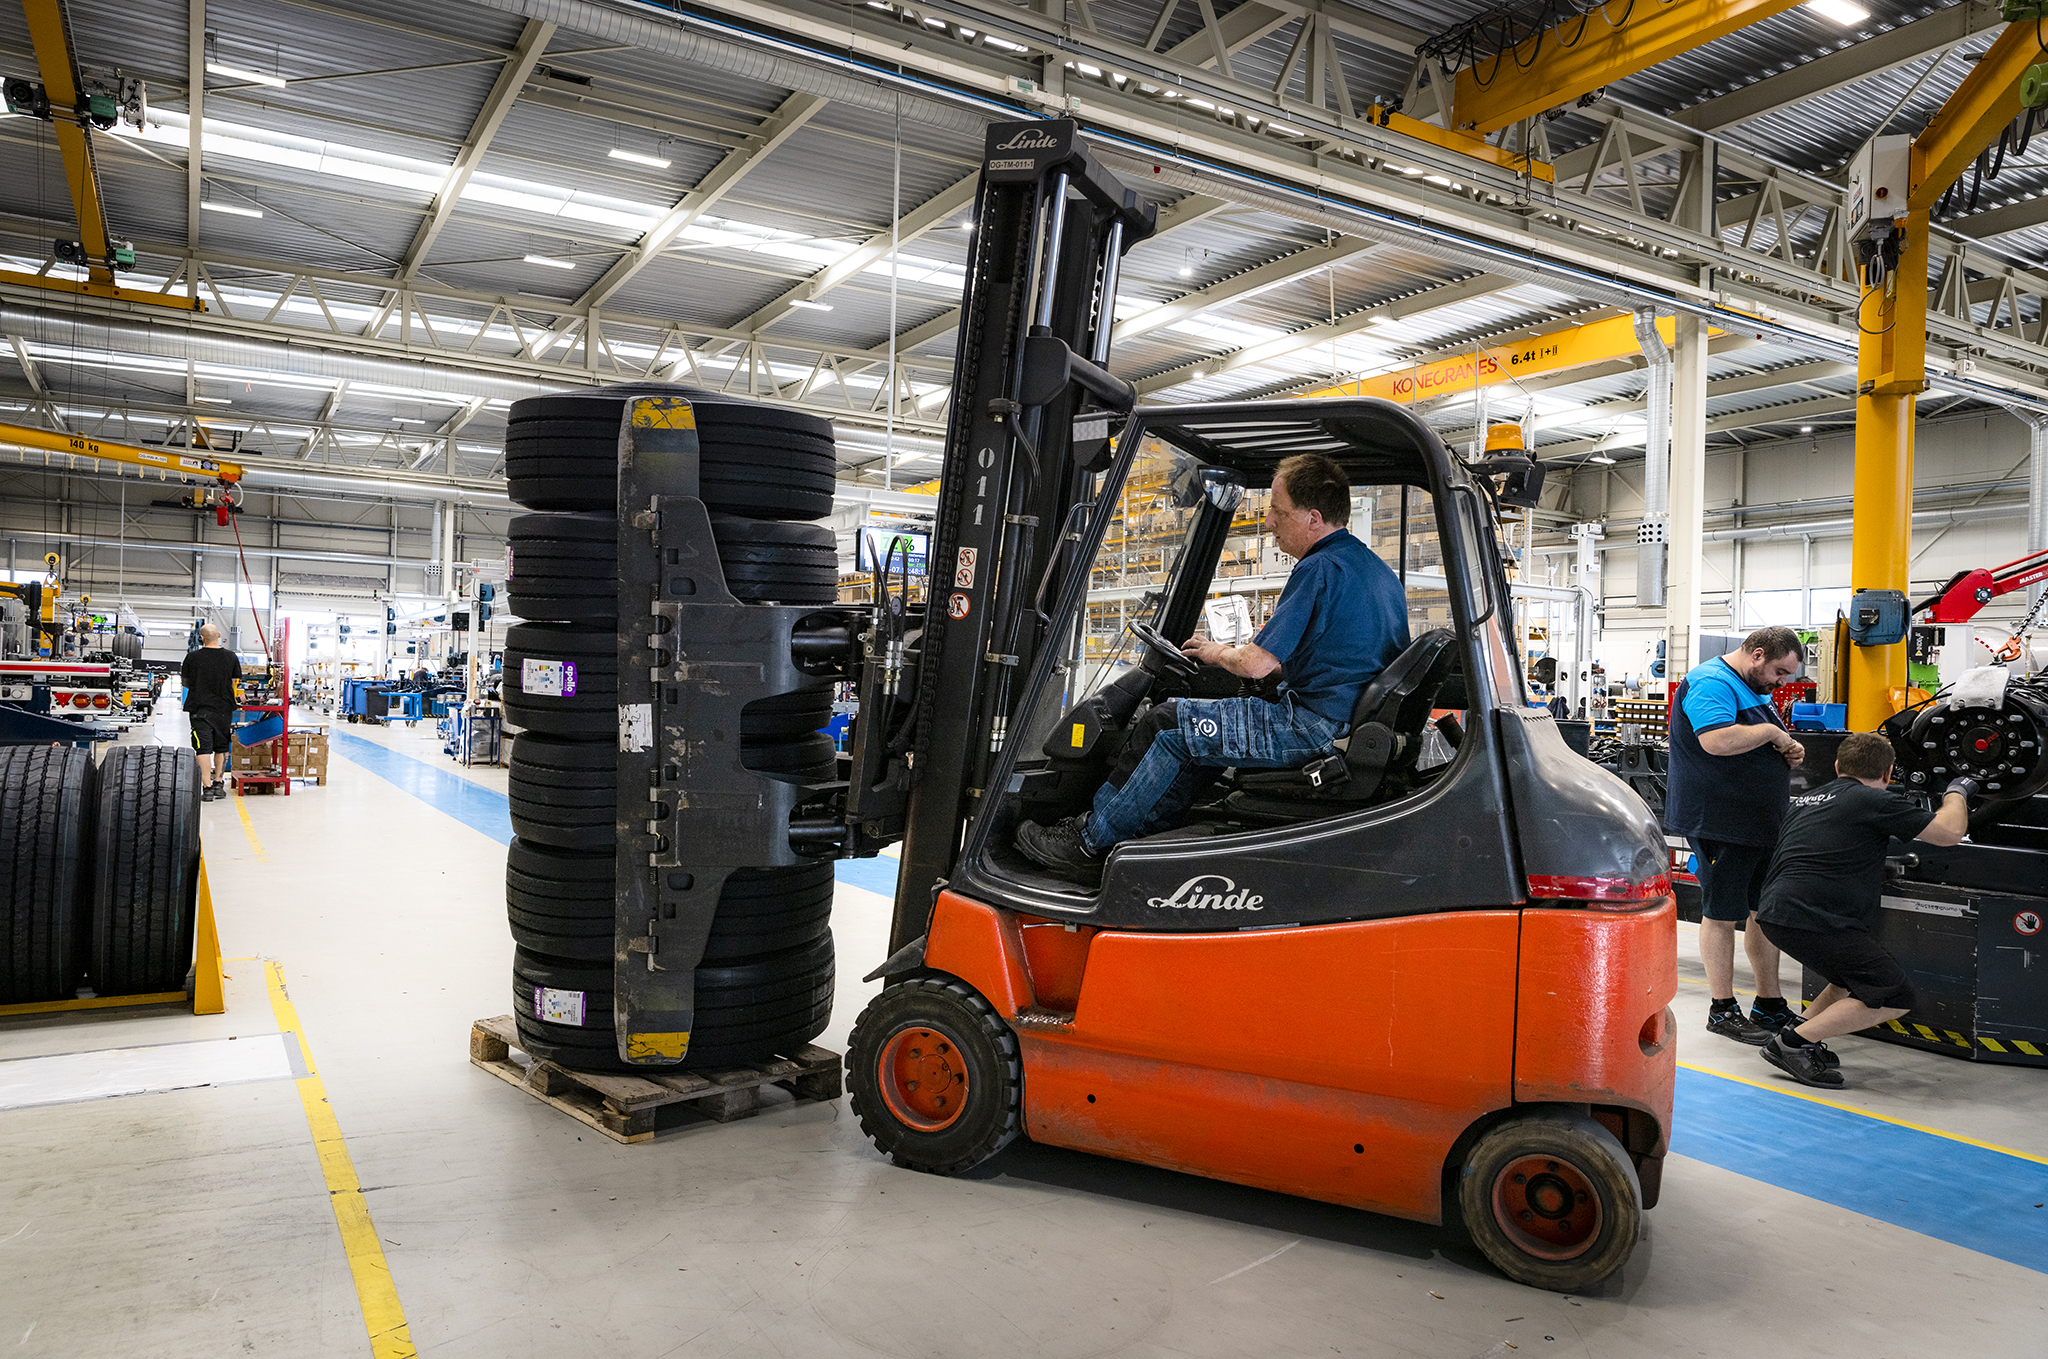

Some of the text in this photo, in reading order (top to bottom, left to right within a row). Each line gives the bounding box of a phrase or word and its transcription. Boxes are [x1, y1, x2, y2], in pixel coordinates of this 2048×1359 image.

[996, 129, 1058, 150] Linde
[1392, 357, 1498, 396] KONECRANES
[1511, 350, 1536, 365] 6.4t
[69, 438, 98, 453] 140 kg
[565, 665, 576, 692] apollo
[1147, 874, 1264, 911] Linde
